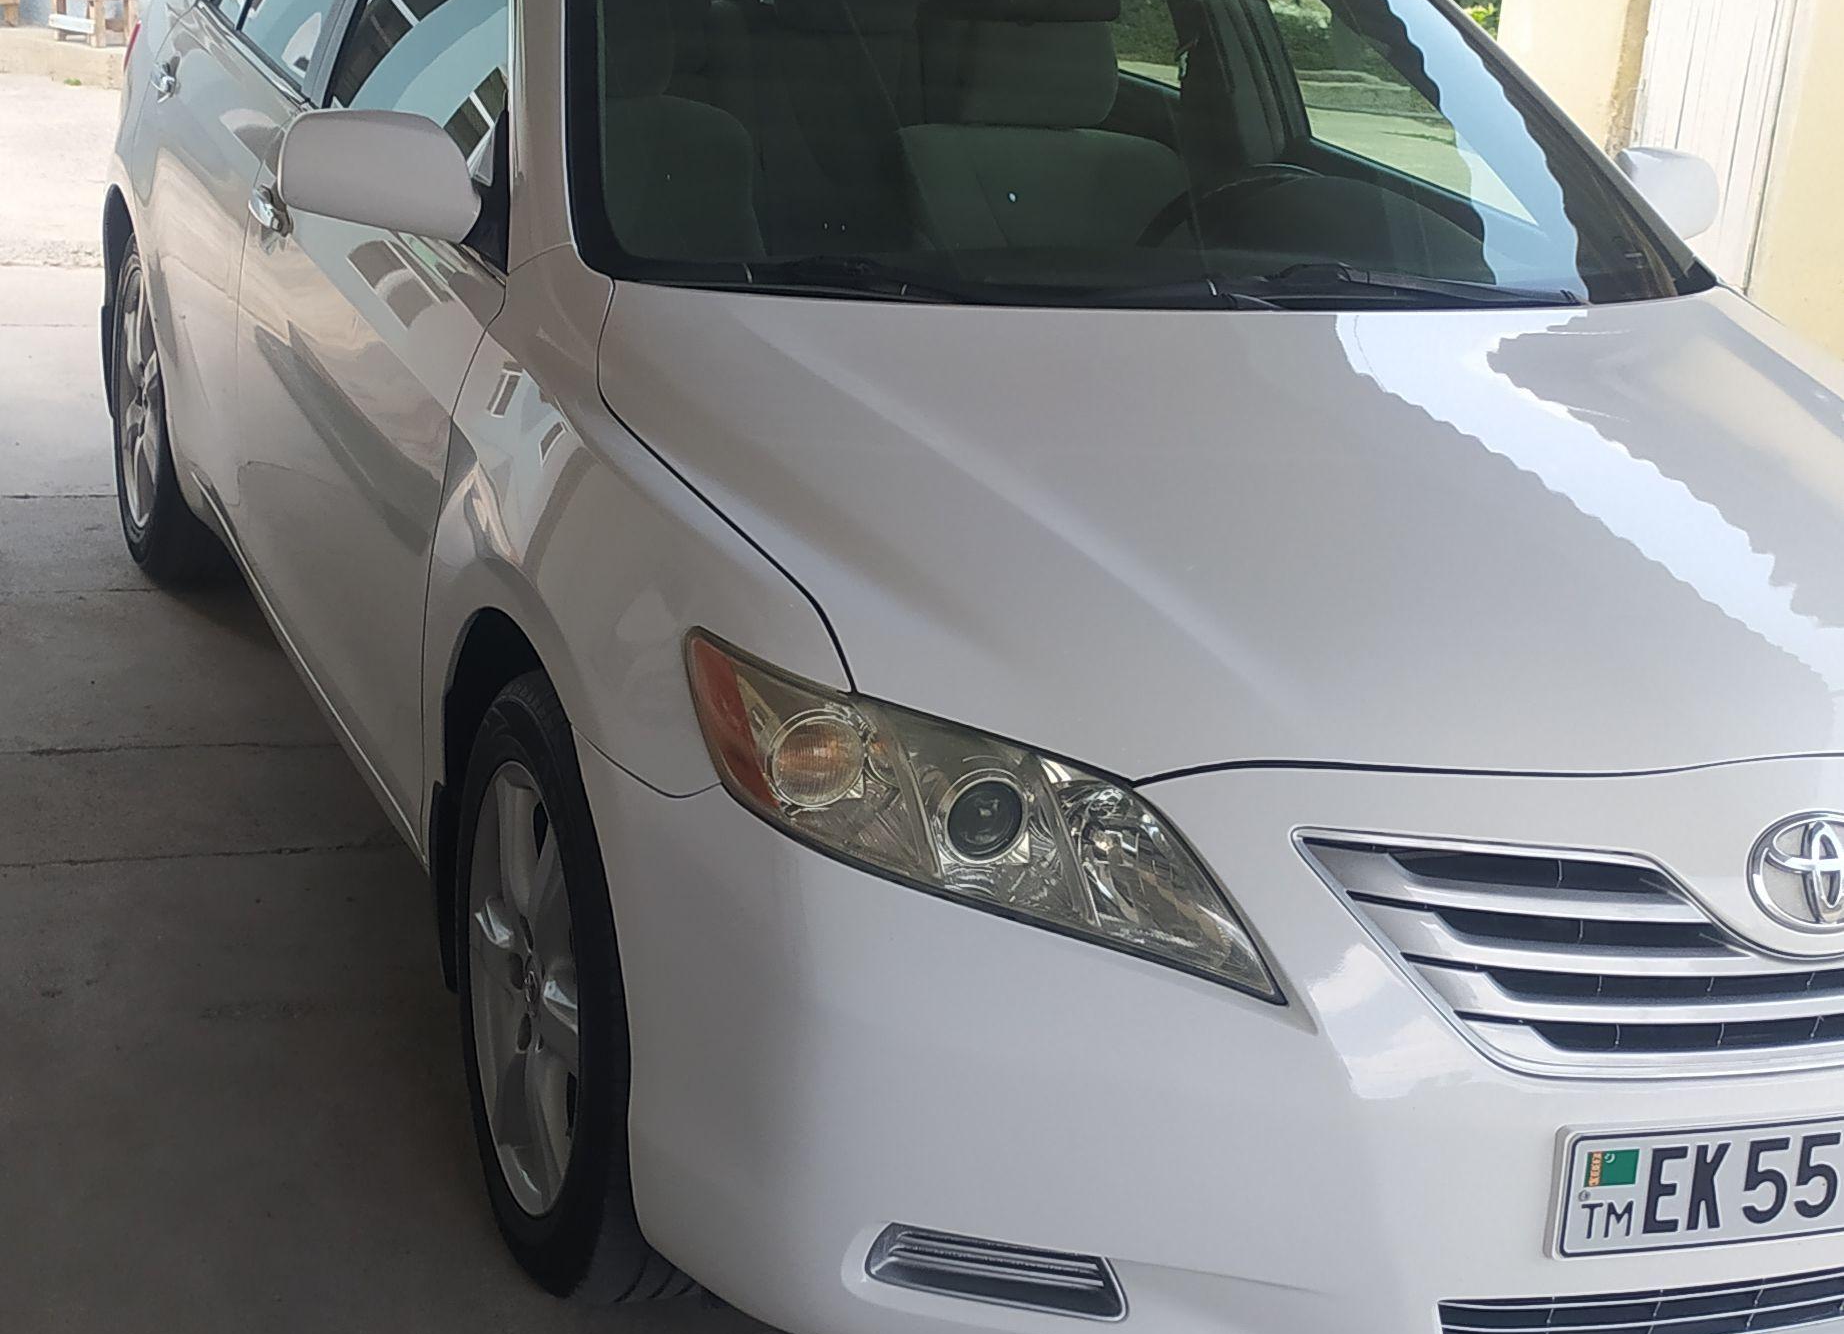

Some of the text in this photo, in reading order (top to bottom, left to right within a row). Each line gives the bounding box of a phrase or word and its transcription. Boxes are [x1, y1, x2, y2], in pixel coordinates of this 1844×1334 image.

[1642, 1131, 1843, 1235] EK 55
[1580, 1200, 1635, 1240] TM
